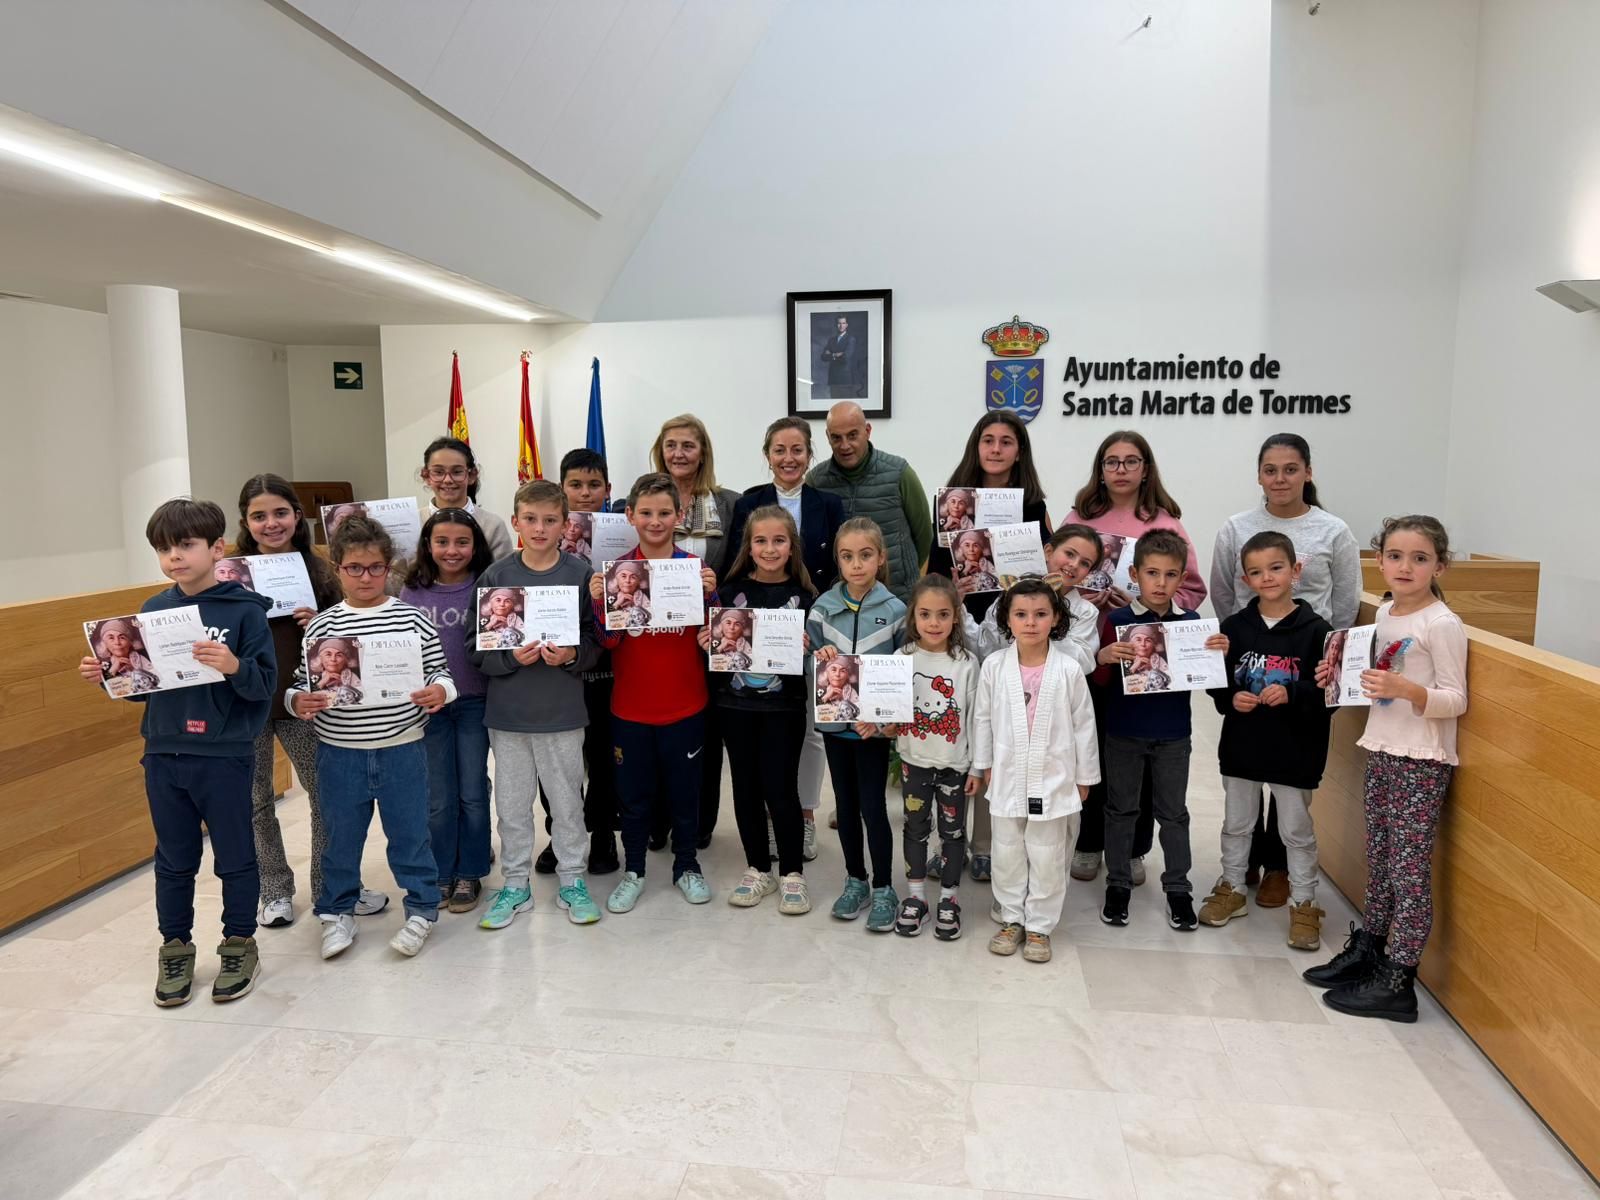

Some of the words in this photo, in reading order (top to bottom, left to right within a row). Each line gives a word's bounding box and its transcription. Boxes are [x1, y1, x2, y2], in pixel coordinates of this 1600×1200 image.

[1063, 353, 1243, 388] Ayuntamiento
[1250, 353, 1280, 379] de
[1063, 391, 1133, 416] Santa
[1140, 390, 1215, 416] Marta
[1222, 389, 1253, 415] de
[1260, 389, 1351, 415] Tormes
[660, 563, 693, 572] DIPLOMA
[535, 589, 571, 597] DIPLOMA
[151, 613, 192, 627] DIPLOMA
[763, 614, 798, 622] DIPLOMA
[1175, 624, 1212, 634] DIPLOMA
[371, 640, 412, 649] DIPLOMA
[870, 659, 905, 667] DIPLOMA
